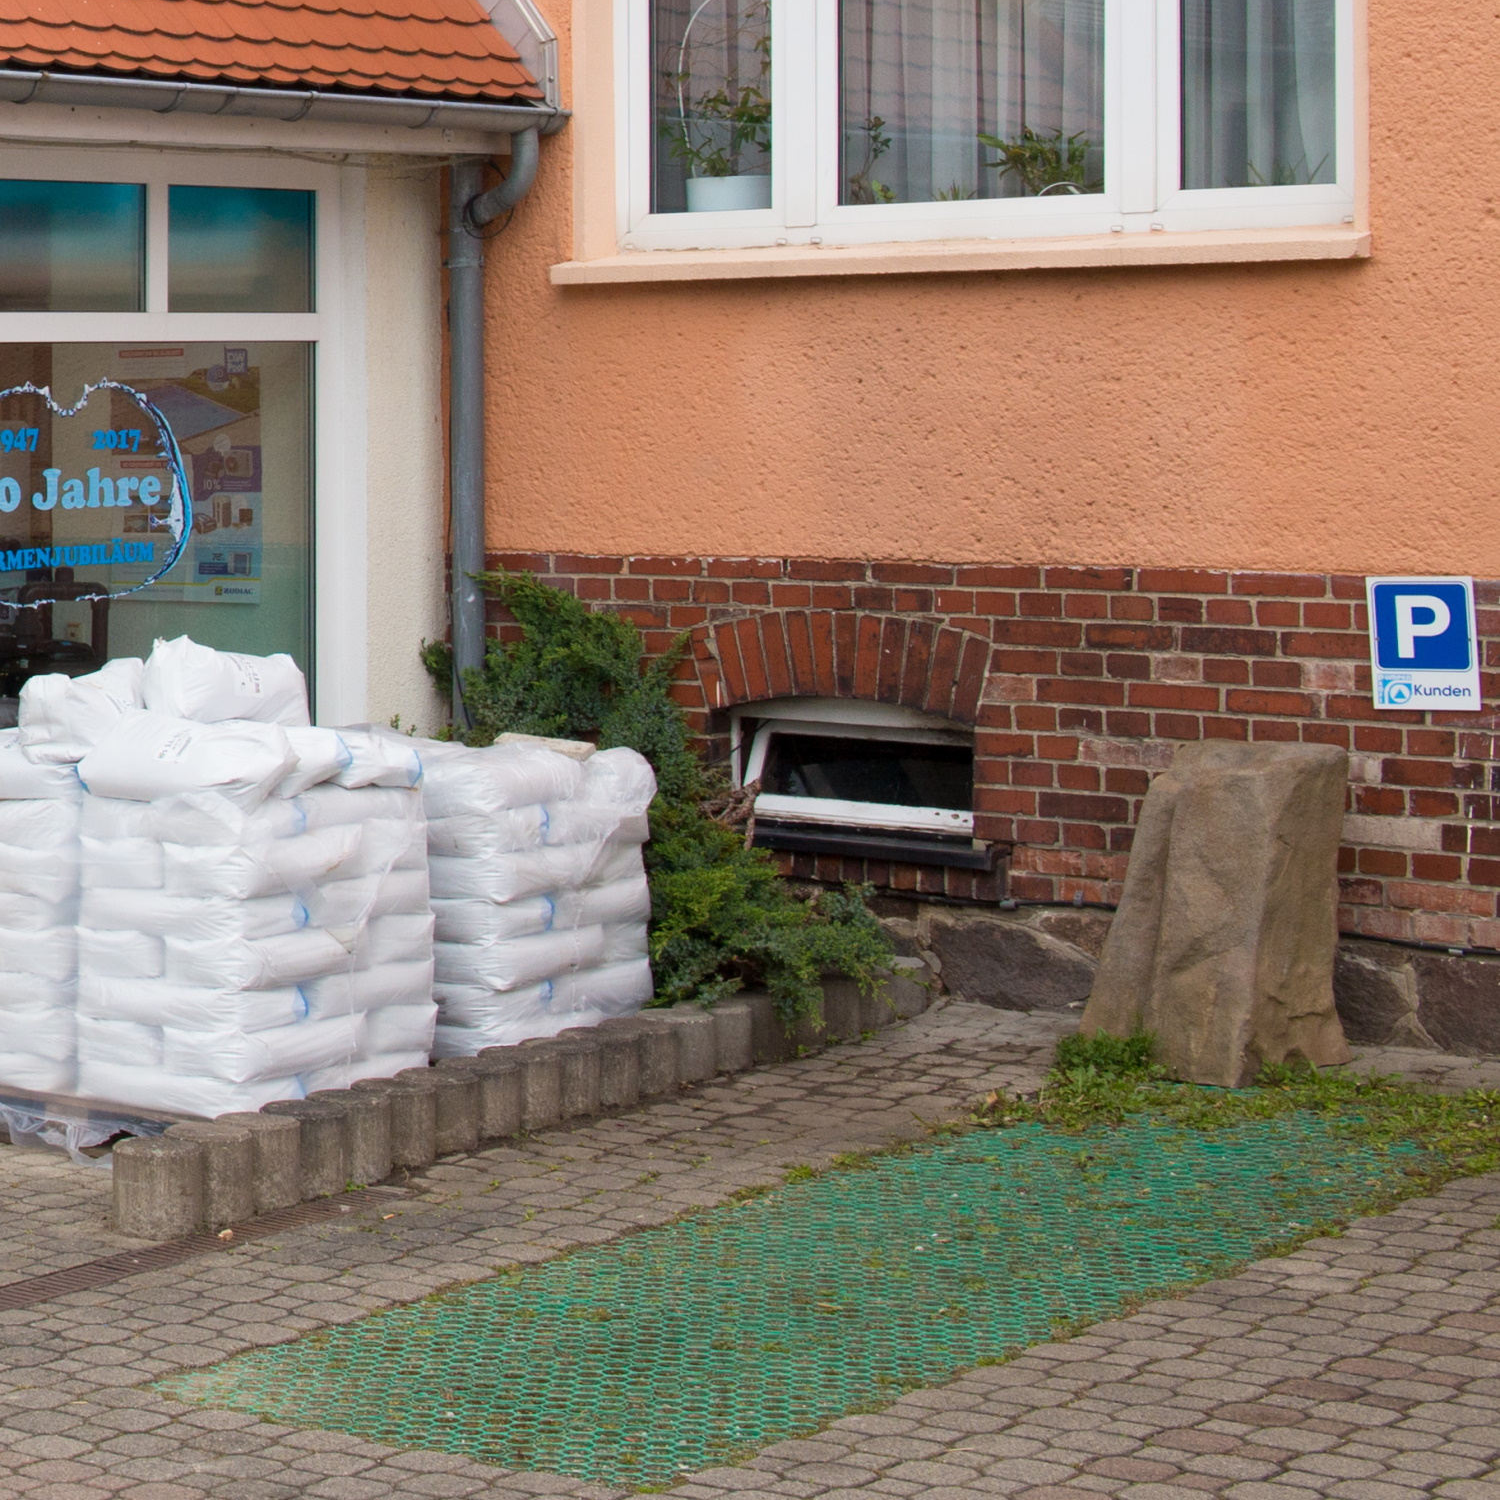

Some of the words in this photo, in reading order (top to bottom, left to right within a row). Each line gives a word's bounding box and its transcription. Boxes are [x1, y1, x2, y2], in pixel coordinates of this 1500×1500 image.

[91, 429, 142, 451] 2017
[33, 467, 161, 512] Jahre
[1394, 595, 1451, 659] P
[1414, 684, 1471, 697] Kunden
